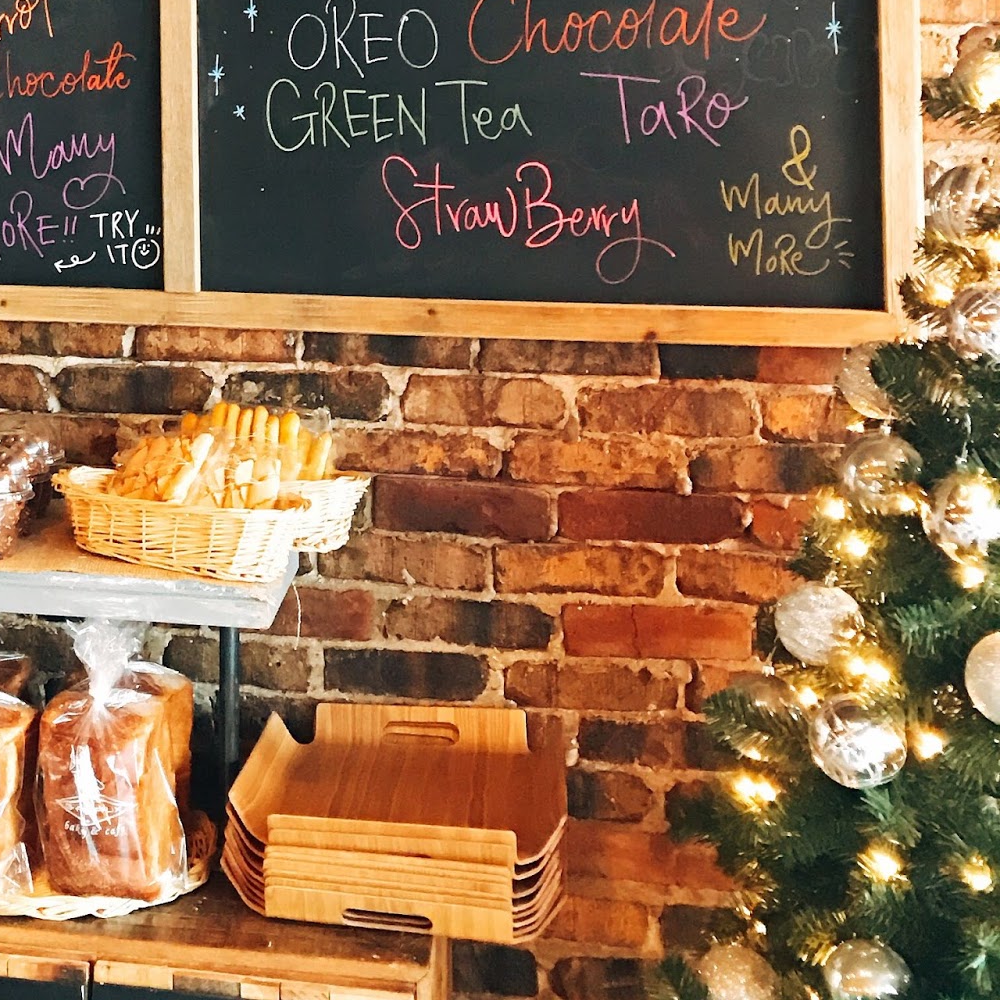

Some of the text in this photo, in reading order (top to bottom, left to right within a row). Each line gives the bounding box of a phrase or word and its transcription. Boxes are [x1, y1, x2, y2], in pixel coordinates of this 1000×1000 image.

[266, 79, 426, 151] GREEN
[435, 80, 532, 144] Tea
[783, 126, 817, 185] &
[90, 209, 139, 239] TRY
[721, 175, 852, 248] Many
[107, 244, 128, 264] IT
